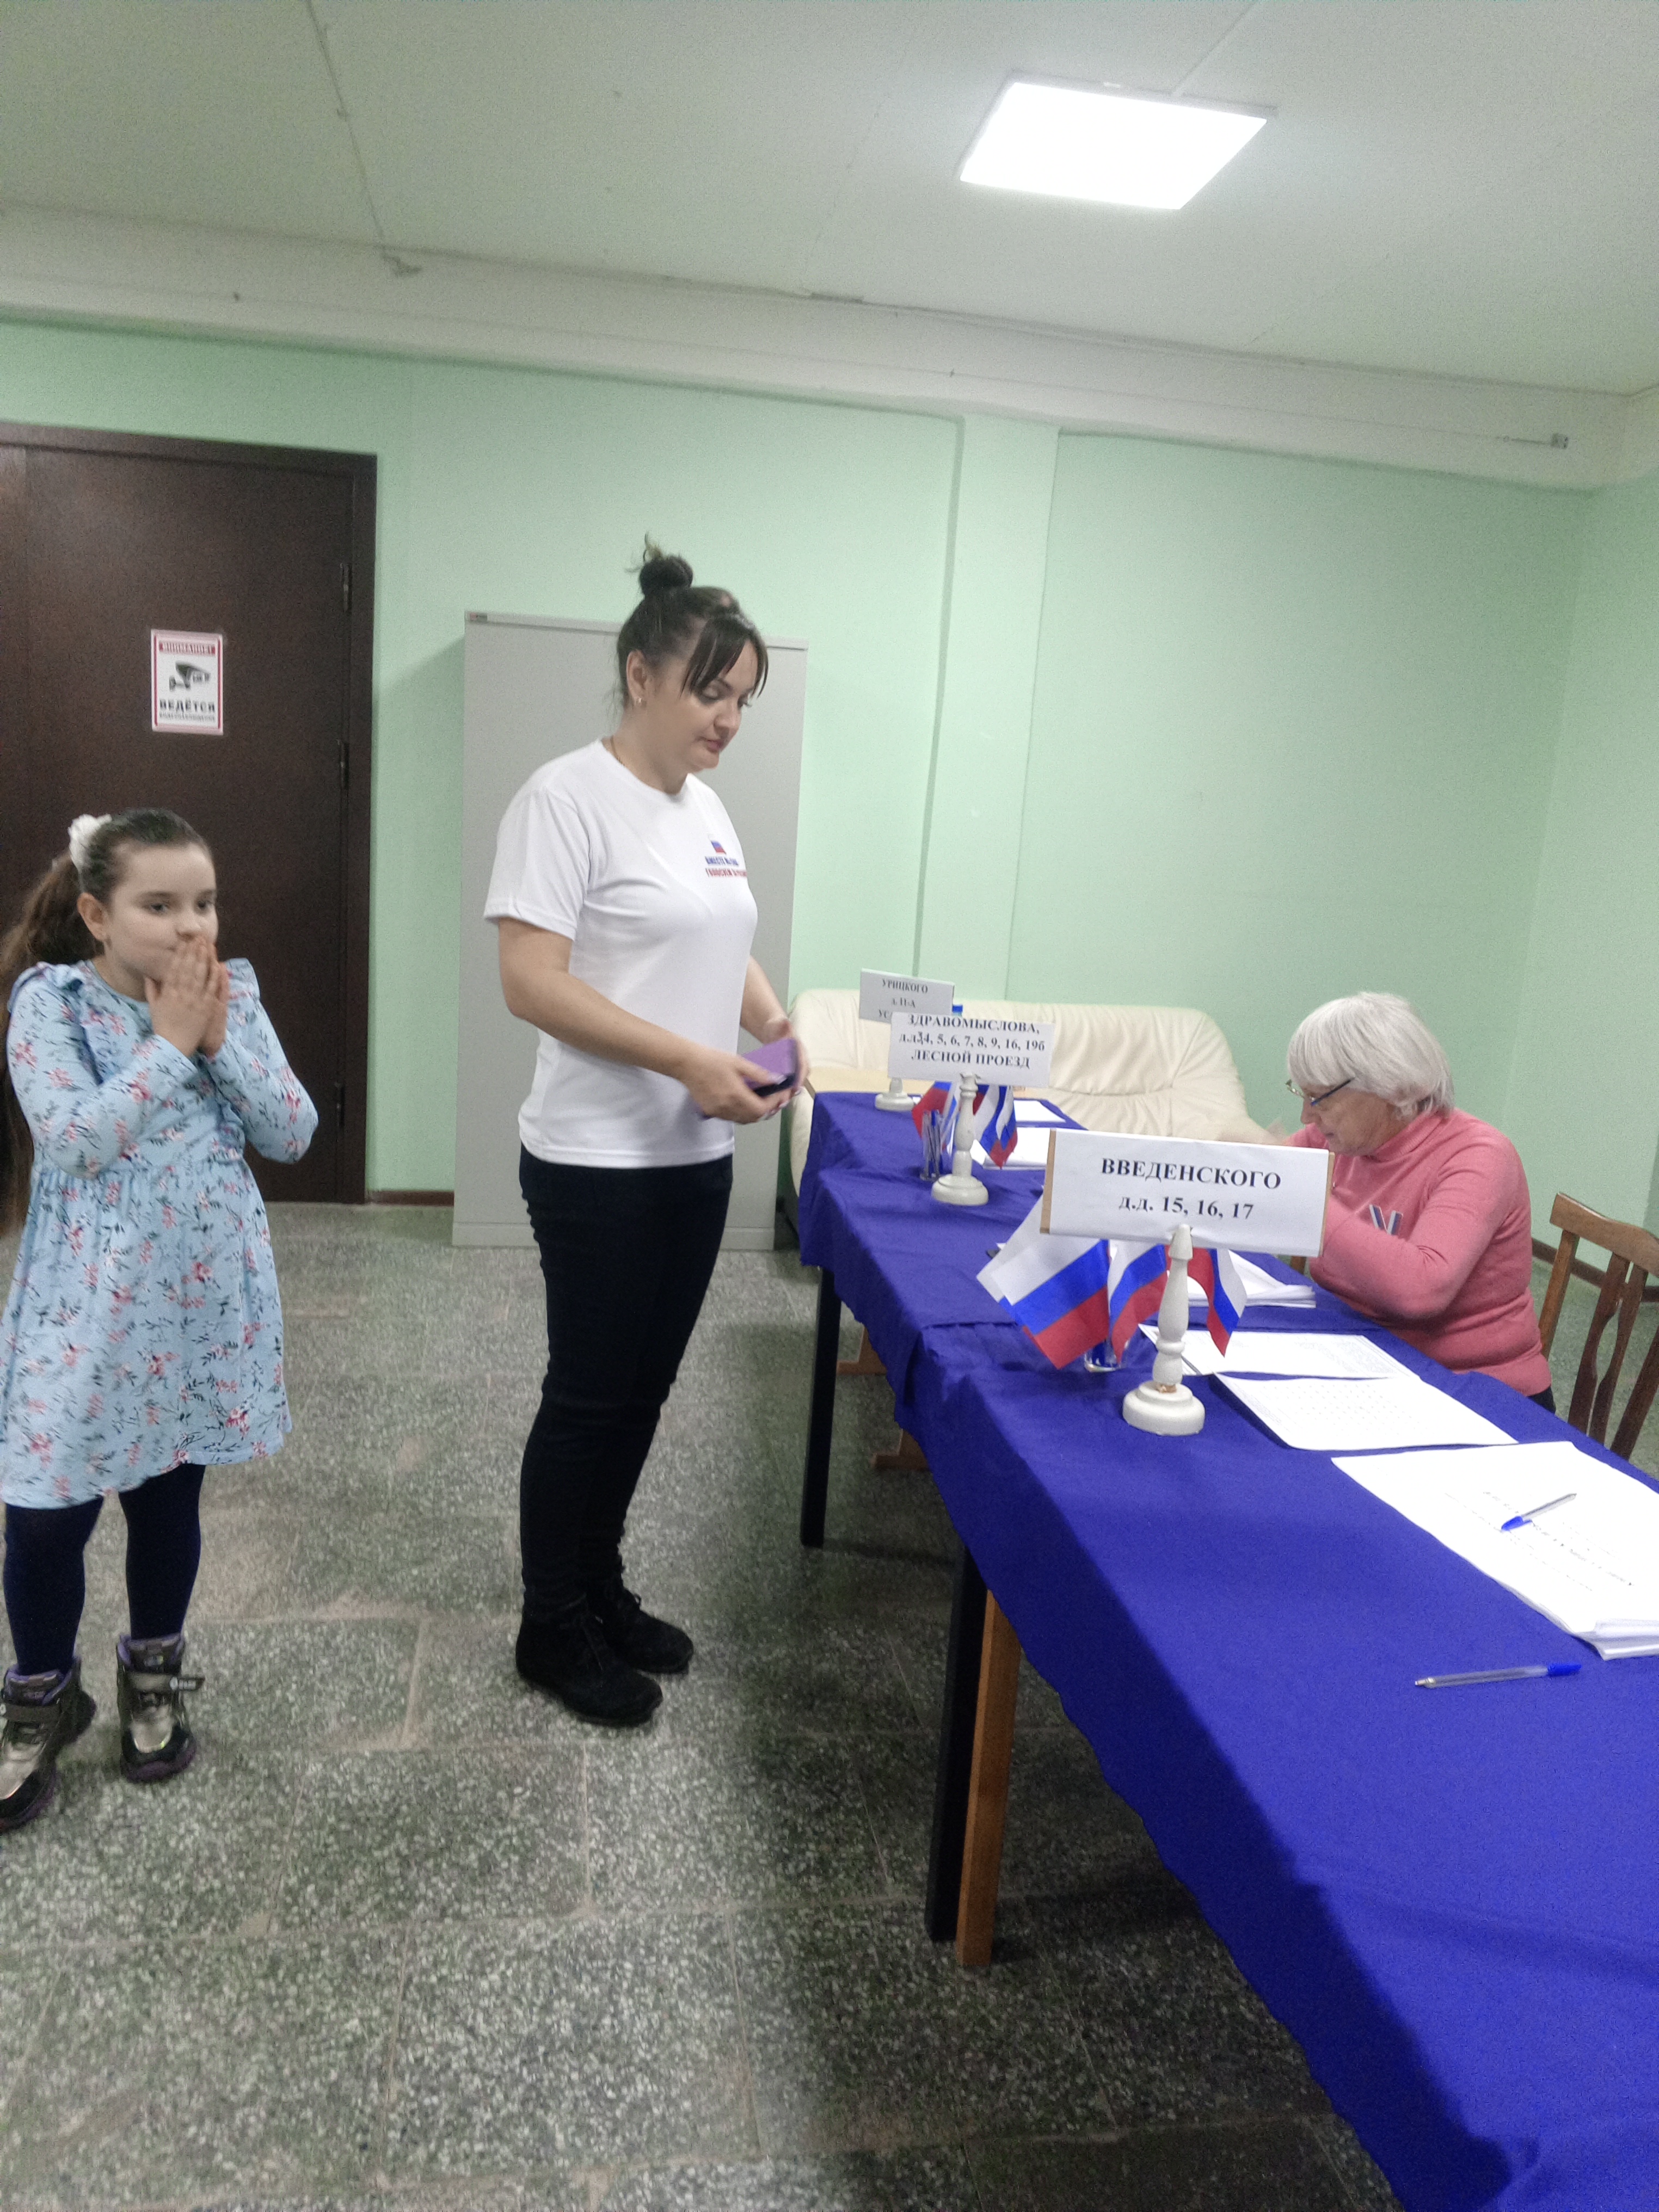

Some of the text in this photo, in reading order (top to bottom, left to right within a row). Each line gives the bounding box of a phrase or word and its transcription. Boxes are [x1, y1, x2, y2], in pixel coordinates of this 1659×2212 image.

[882, 979, 928, 993] УРИЦКОГО
[908, 1015, 1040, 1034] ЗДРАВОМЫСЛОВА,
[937, 1034, 947, 1046] 5,
[951, 1034, 960, 1046] 6,
[964, 1036, 974, 1047] 7,
[978, 1036, 987, 1048] 8,
[991, 1037, 1000, 1049] 9,
[1006, 1039, 1021, 1050] 16,
[911, 1049, 1029, 1068] ЛЕСНОЙ ПРОЕЗД
[1102, 1158, 1281, 1189] ВВЕДЕНСКОГО
[1162, 1196, 1189, 1216] 15,
[1197, 1200, 1224, 1220] 16,
[1232, 1203, 1254, 1220] 17
